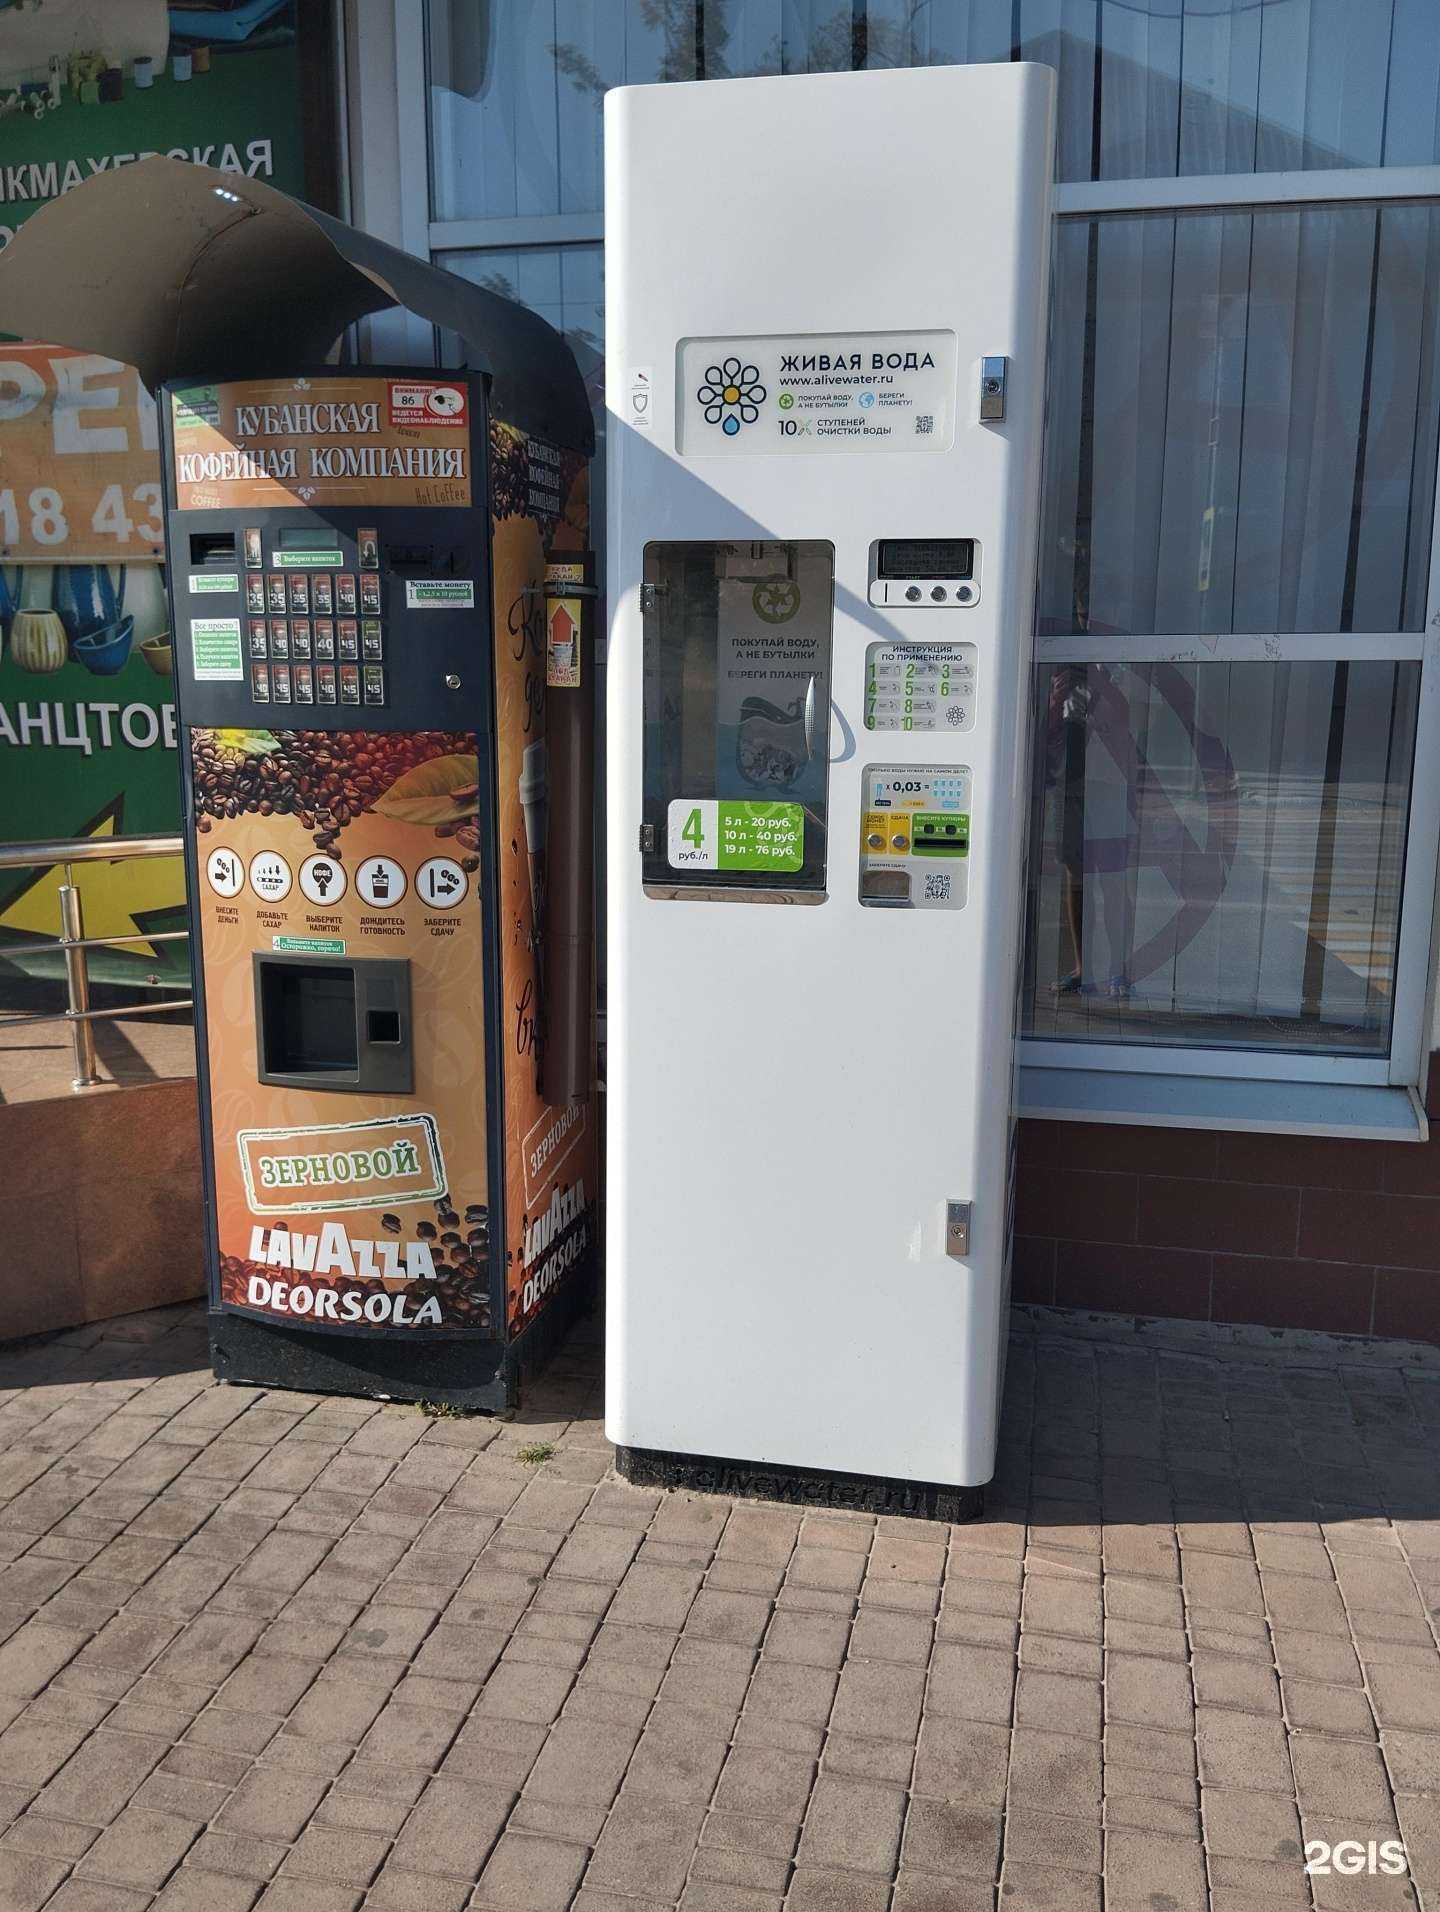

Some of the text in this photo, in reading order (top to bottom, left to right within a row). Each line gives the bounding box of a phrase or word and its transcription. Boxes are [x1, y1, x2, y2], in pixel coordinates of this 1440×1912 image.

[779, 352, 936, 372] ЖИВАЯ ВОДА
[779, 373, 894, 387] www.alivewater.ru
[401, 395, 416, 405] 86
[798, 394, 832, 402] ПОКУПАЙ
[878, 392, 905, 400] БЕРЕГИ
[235, 402, 381, 437] КУБАНСКАЯ
[817, 418, 866, 427] СТУПЕНЕЙ
[817, 427, 892, 436] ОЧИСТКИ ВОДЫ
[177, 442, 467, 483] КОФЕЙНАЯ КОМПАНИЯ
[250, 593, 263, 603] 35
[271, 593, 285, 604] 35
[341, 593, 354, 603] 40
[364, 595, 377, 604] 45
[252, 638, 378, 649] 35 40 40 40 45 45
[731, 636, 820, 650] ПОКУПАЙ ВОДУ,
[892, 645, 953, 653] ИНСТРУКЦИЯ
[736, 649, 816, 660] А НЕ БУТЫЛКИ
[897, 654, 963, 662] ПРИМЕНЕНИЮ
[728, 670, 767, 680] БЕРЕГИ
[869, 663, 876, 678] 1
[906, 663, 915, 679] 2
[942, 664, 950, 679] 3
[256, 683, 381, 693] 40 45 45 40 45 45
[868, 681, 877, 695] 4
[905, 682, 913, 696] 5
[940, 682, 949, 696] 6
[868, 698, 877, 713] 7
[904, 699, 912, 713] 8
[868, 716, 876, 730] 9
[901, 716, 913, 731] 10
[892, 782, 922, 794] 0,03
[681, 808, 705, 849] 4
[725, 817, 733, 827] 5
[734, 818, 742, 827] л
[751, 817, 766, 827] 20
[767, 817, 792, 830] руб.
[725, 830, 735, 840] 10
[737, 831, 746, 840] л
[757, 831, 771, 841] 40
[773, 831, 798, 843] руб.
[678, 850, 709, 863] руб./л
[725, 844, 736, 854] 19
[738, 845, 746, 854] л
[756, 845, 769, 855] 76
[771, 845, 796, 858] руб.
[215, 906, 240, 915] ВНЕСИТЕ
[256, 911, 289, 920] ДОБАВЬТЕ
[217, 915, 239, 924] ДЕНЬГИ
[262, 919, 282, 928] САХАР
[306, 915, 344, 924] ВЫБЕРИТЕ
[360, 917, 406, 926] ДОЖДИТЕСЬ
[424, 918, 462, 927] ЗАБЕРИТЕ
[309, 924, 341, 933] НАПИТОК
[360, 927, 406, 936] ГОТОВНОСТЬ
[430, 928, 455, 937] СДАЧУ
[259, 1140, 421, 1186] ЗЕРНОВОЙ
[248, 1222, 438, 1279] LAVAZZA
[522, 1230, 587, 1314] DEORSOLA
[247, 1275, 443, 1325] DEORSOLA
